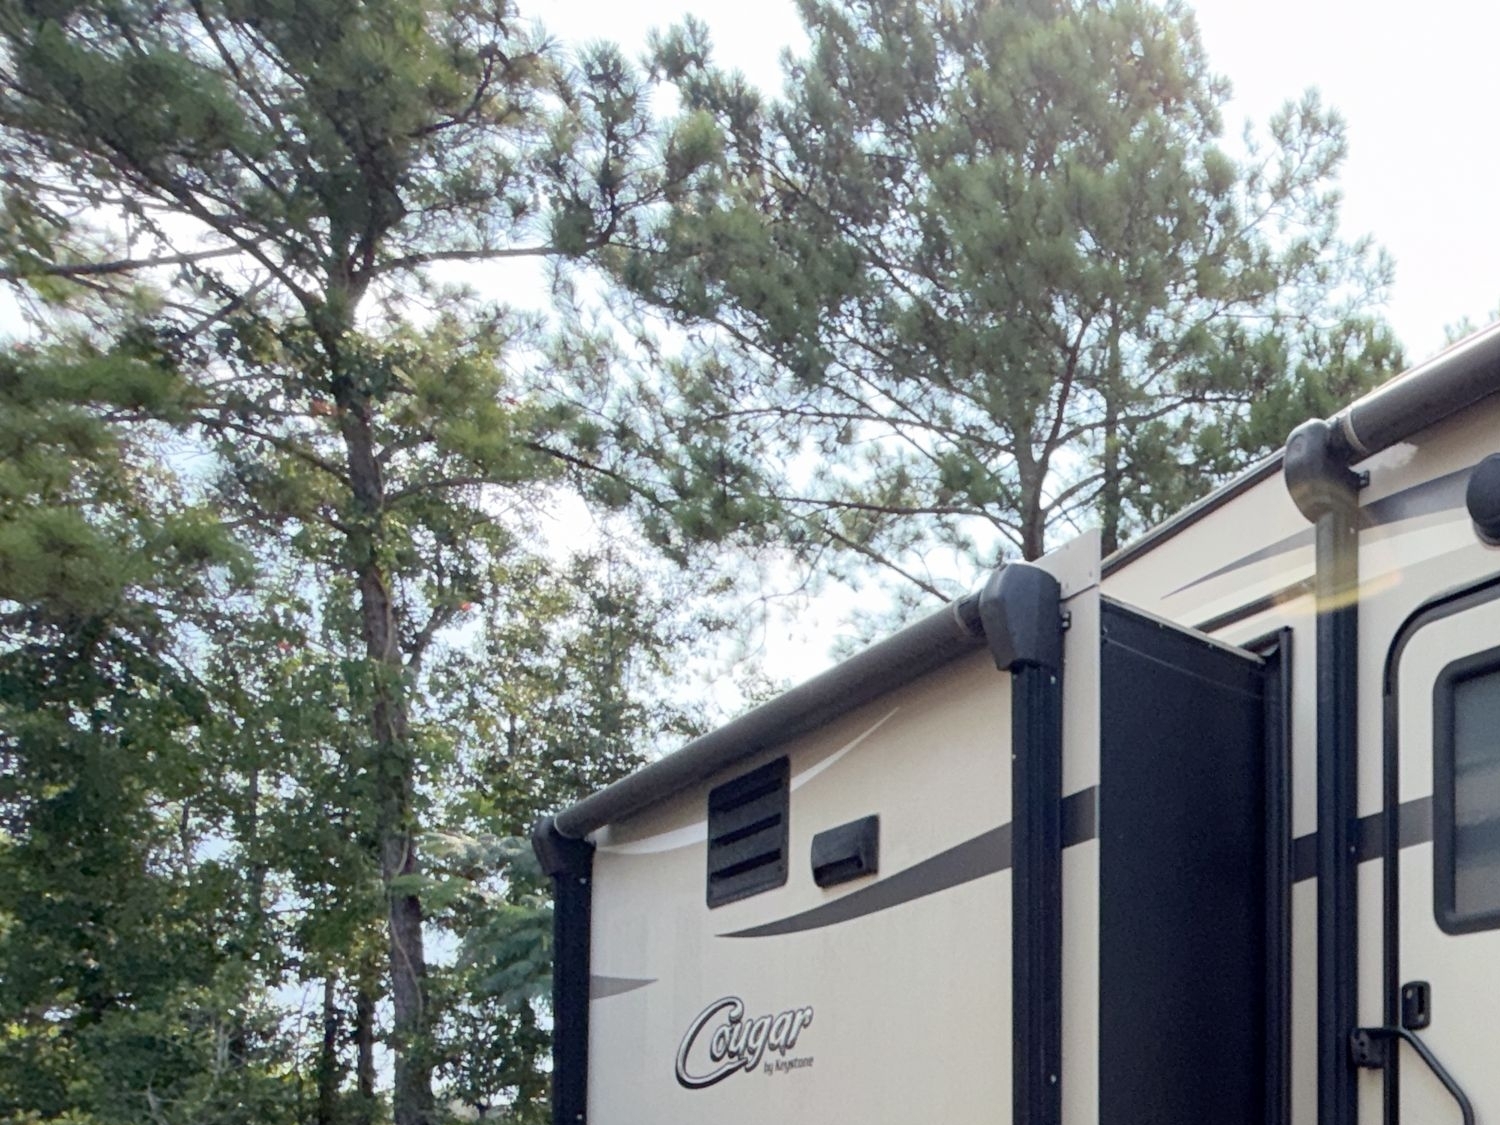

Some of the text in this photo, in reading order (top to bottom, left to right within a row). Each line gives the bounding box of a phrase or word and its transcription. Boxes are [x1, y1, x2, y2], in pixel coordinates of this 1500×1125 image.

[675, 996, 814, 1090] Cougar
[763, 1056, 814, 1076] by Keystone
